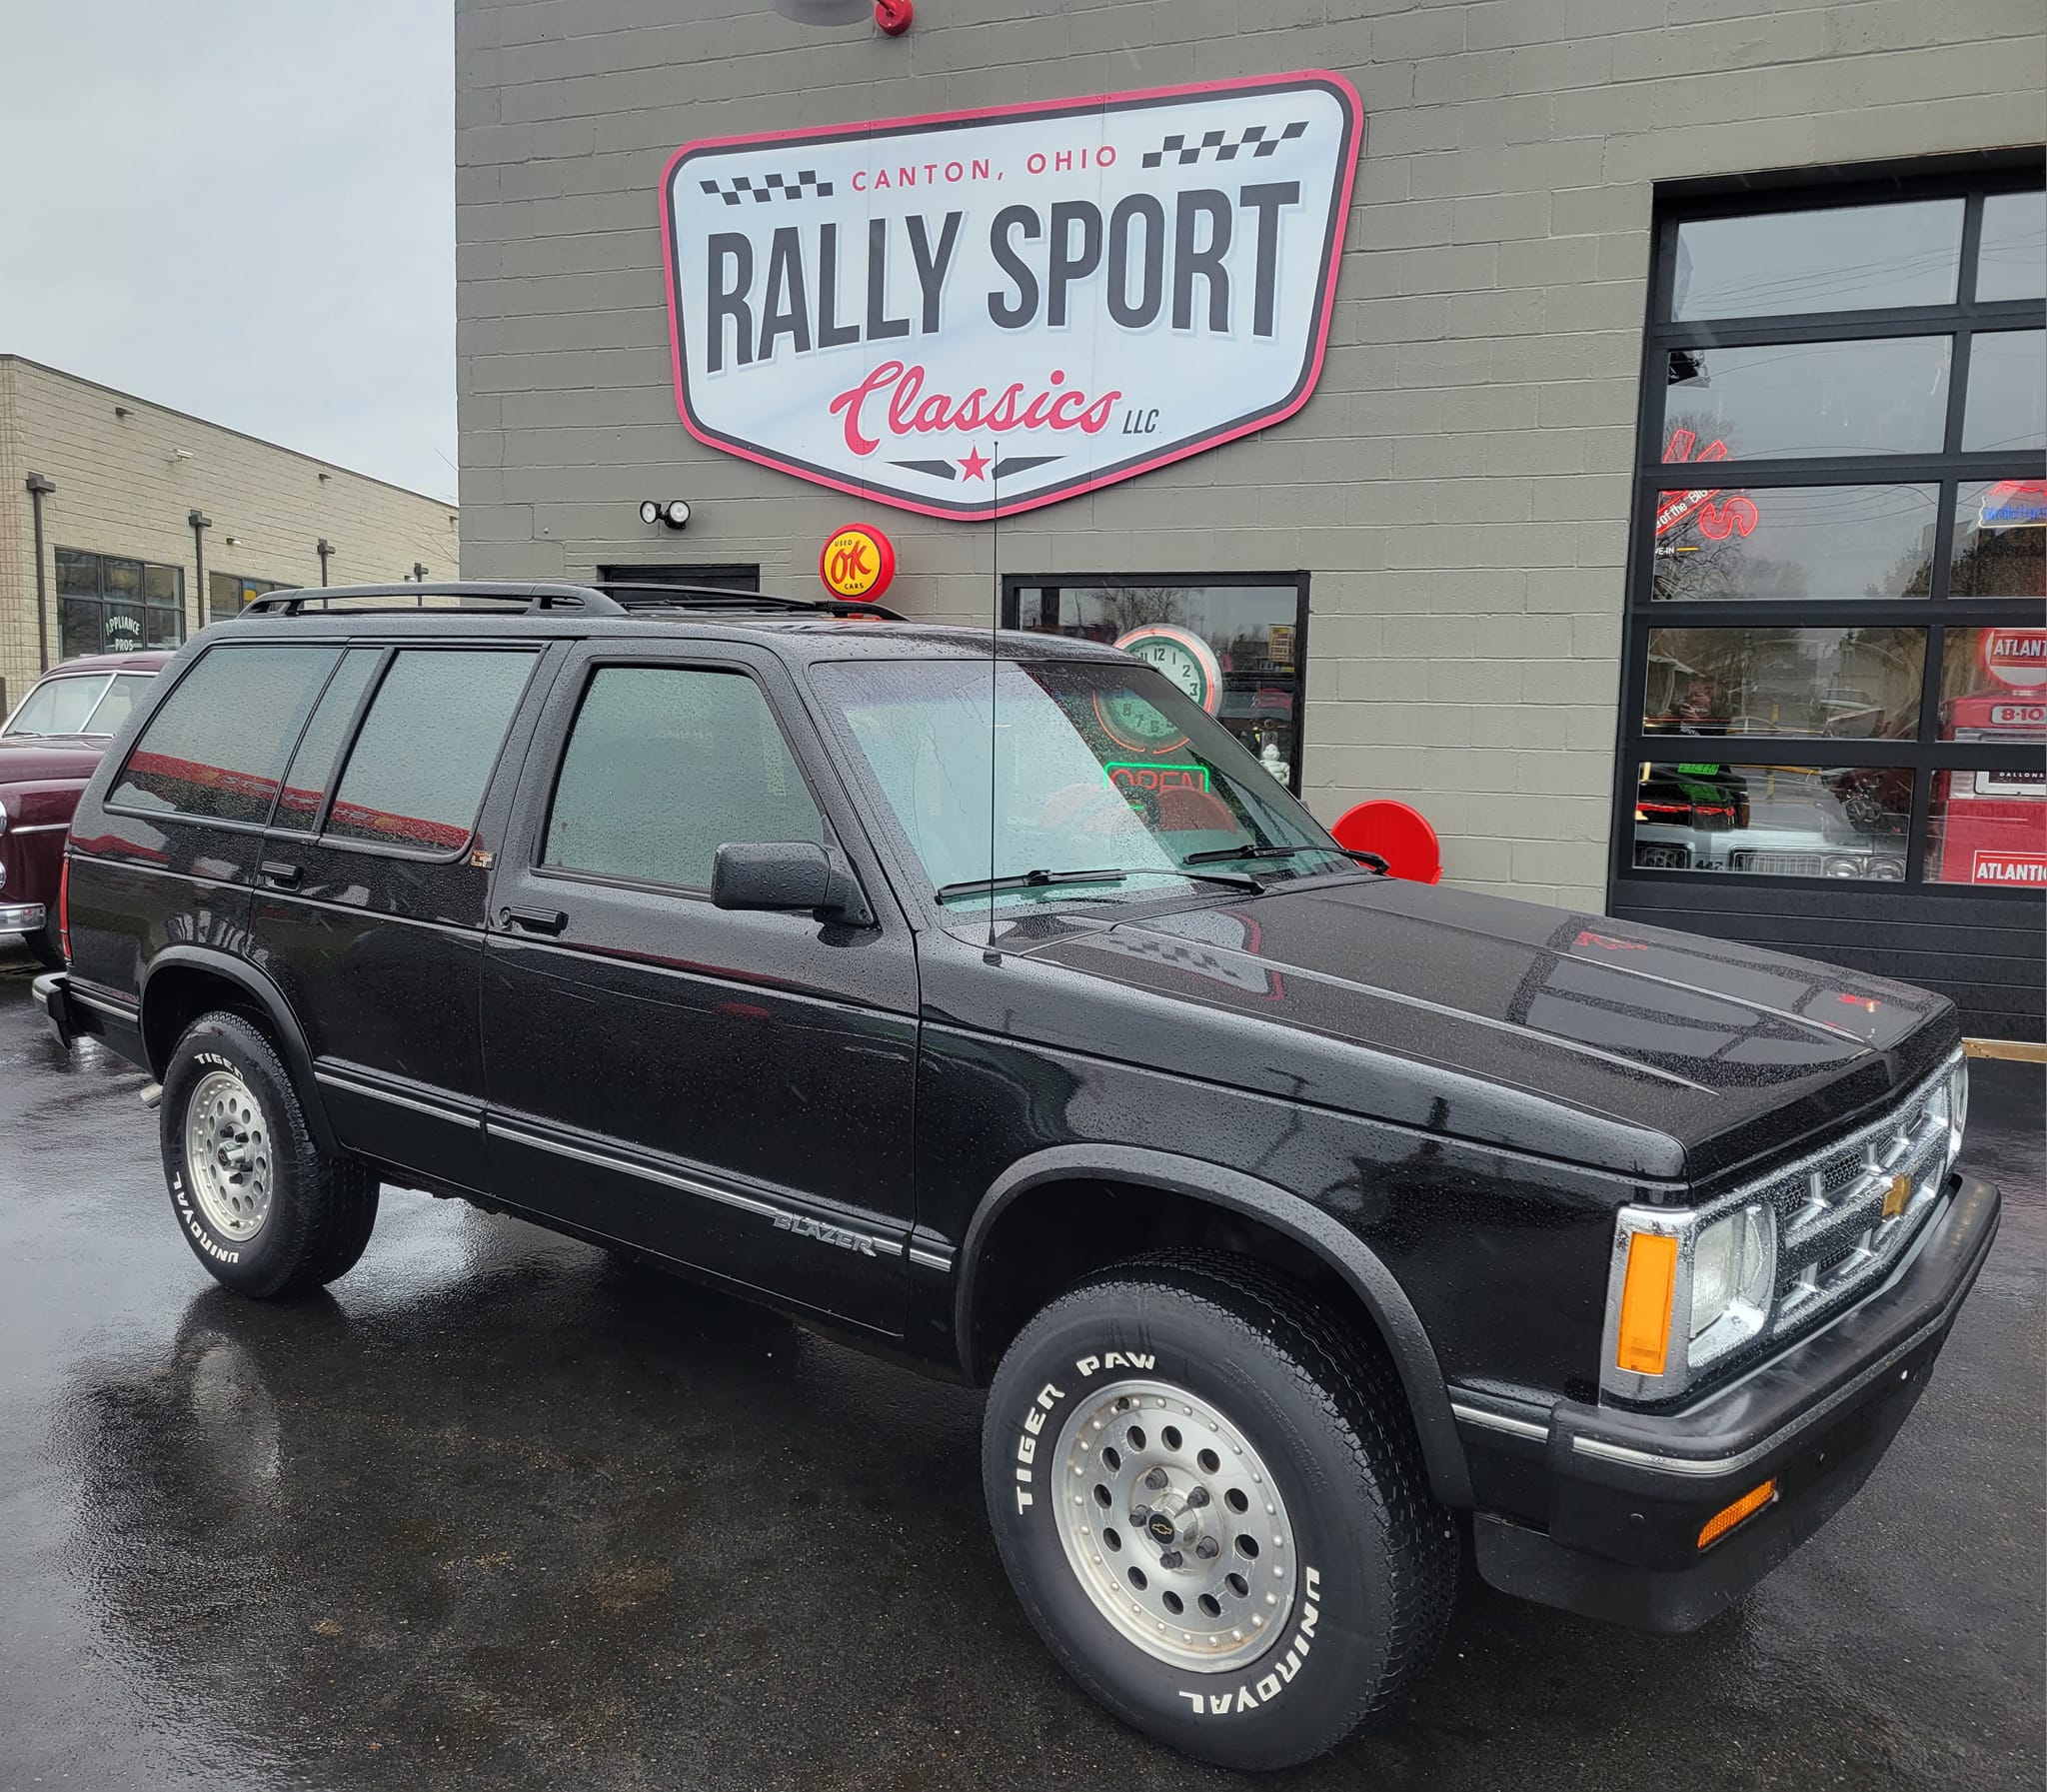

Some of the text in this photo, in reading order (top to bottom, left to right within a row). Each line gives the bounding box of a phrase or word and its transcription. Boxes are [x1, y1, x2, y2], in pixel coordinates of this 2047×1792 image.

[852, 145, 1117, 192] CANTON, OHIO
[707, 181, 1300, 374] RALLY SPORT
[829, 360, 1159, 456] Classics LLC
[831, 541, 872, 584] OK
[105, 616, 140, 637] APPLIANCE
[115, 639, 134, 652] PROS
[1153, 649, 1165, 662] 12
[1172, 652, 1176, 665] 1
[1182, 665, 1191, 678] 2
[1189, 683, 1198, 697] 3
[1134, 715, 1144, 729] 7
[2001, 708, 2045, 722] 8-10
[1110, 769, 1204, 793] OPEN
[173, 1171, 240, 1263] UNIROYAL
[773, 1211, 878, 1257] BLAZER
[1016, 1351, 1156, 1515] TIGER PAW
[1179, 1566, 1320, 1715] UNIROYAL
